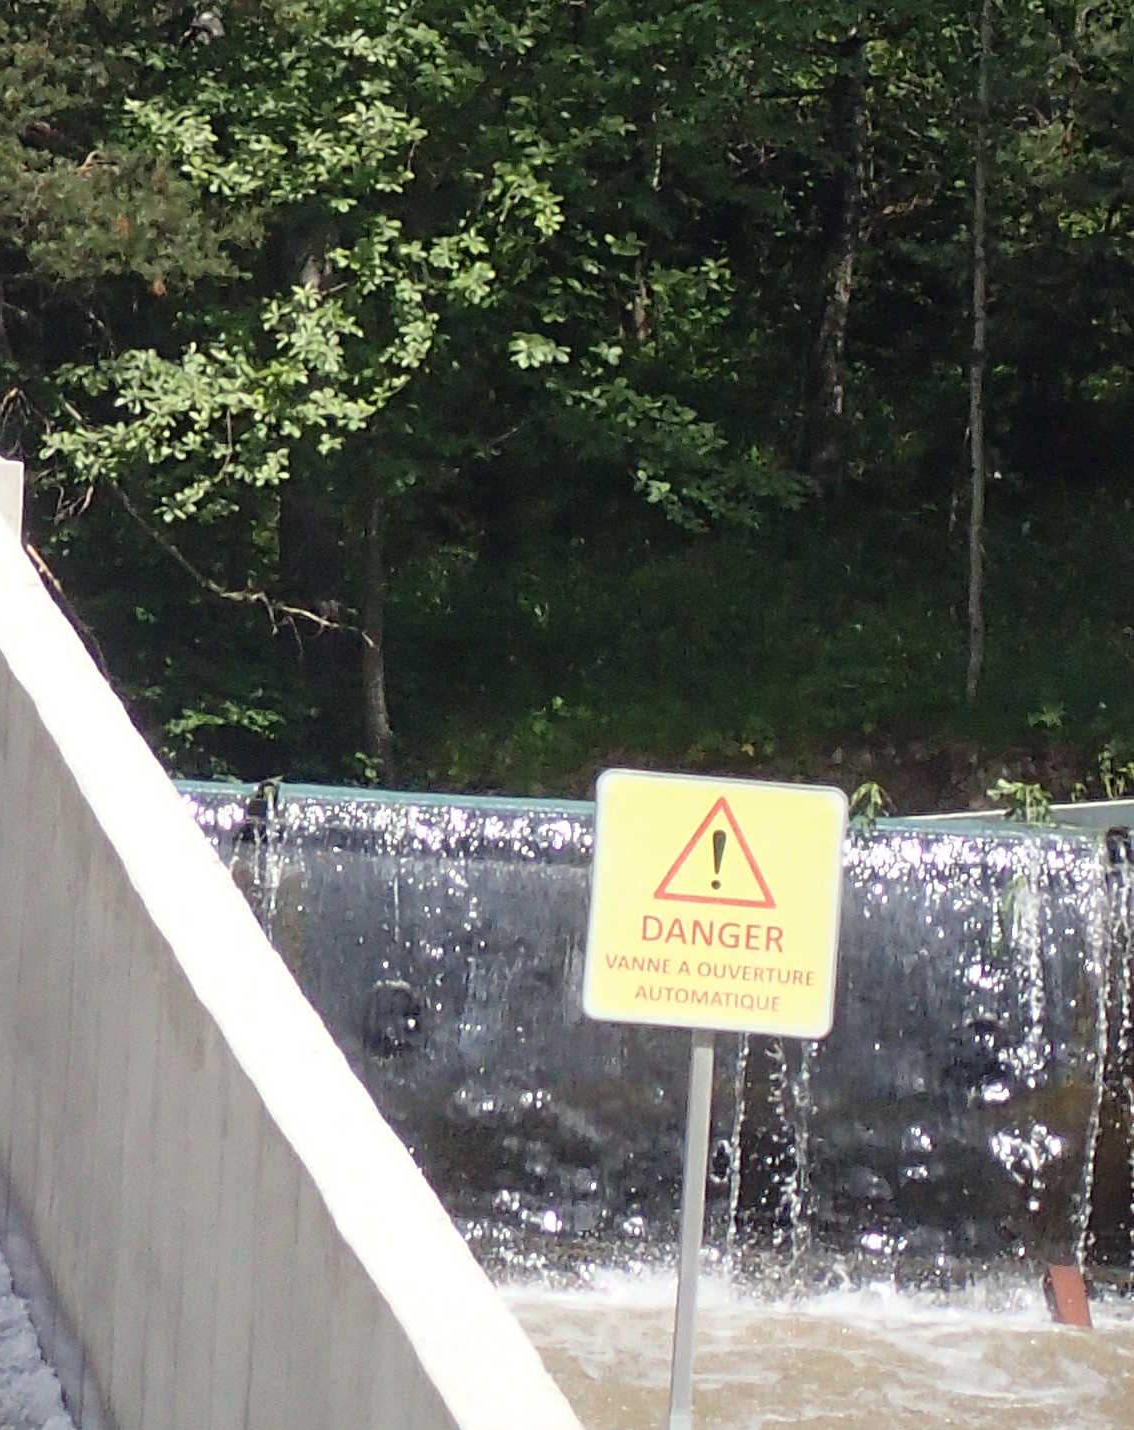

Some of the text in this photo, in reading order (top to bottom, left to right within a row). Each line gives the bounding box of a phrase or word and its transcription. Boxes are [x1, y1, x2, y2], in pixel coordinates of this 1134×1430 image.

[641, 914, 784, 953] DANGER
[605, 953, 816, 987] VANNE A OUVERTURE
[634, 985, 782, 1012] AUTOMATIQUE
